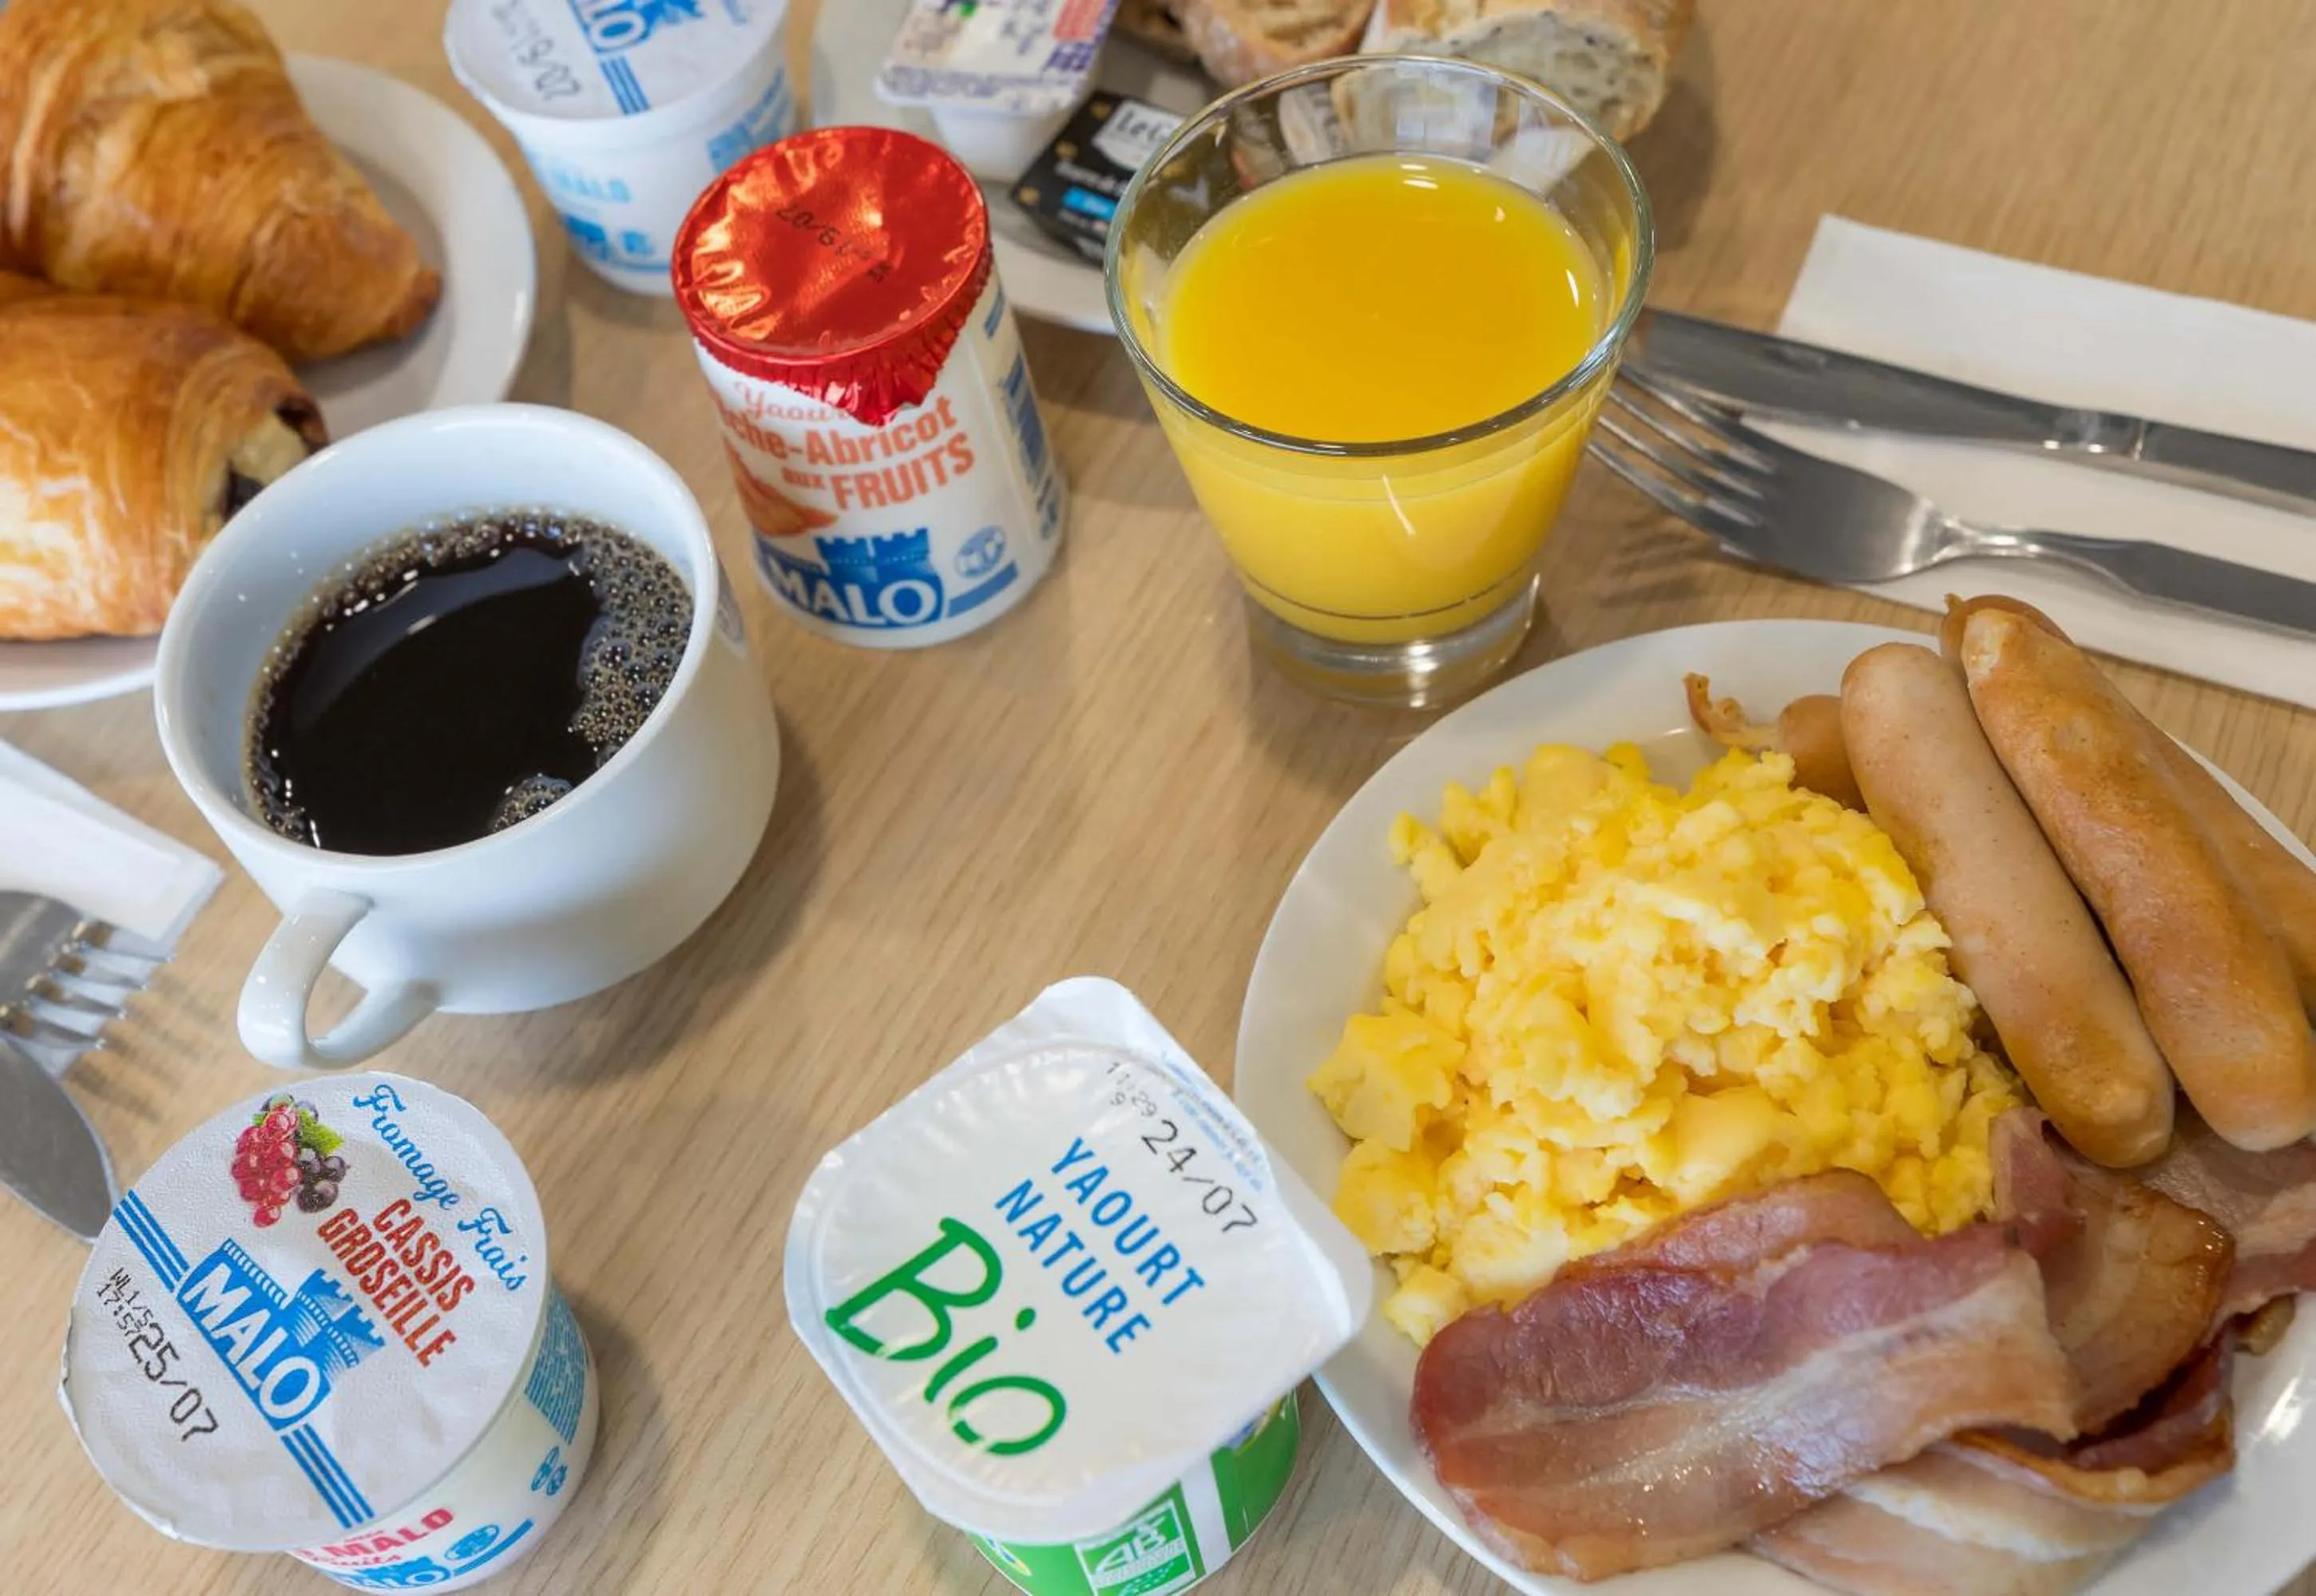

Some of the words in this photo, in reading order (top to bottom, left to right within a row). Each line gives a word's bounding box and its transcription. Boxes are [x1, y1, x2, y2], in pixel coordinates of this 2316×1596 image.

[720, 396, 957, 466] che-Abricot
[830, 432, 976, 511] FRUITS
[767, 552, 938, 626] MALO
[352, 1083, 461, 1211] Fromage
[457, 1207, 529, 1292] Frais
[1051, 1139, 1205, 1307] YAOURT
[1140, 1119, 1259, 1234] 24/07
[317, 1208, 458, 1368] GROSEILLE
[373, 1198, 475, 1312] CASSIS
[995, 1179, 1152, 1353] NATURE
[128, 1322, 220, 1442] 25/07
[182, 1261, 320, 1420] MALO
[321, 1508, 454, 1558] MALO
